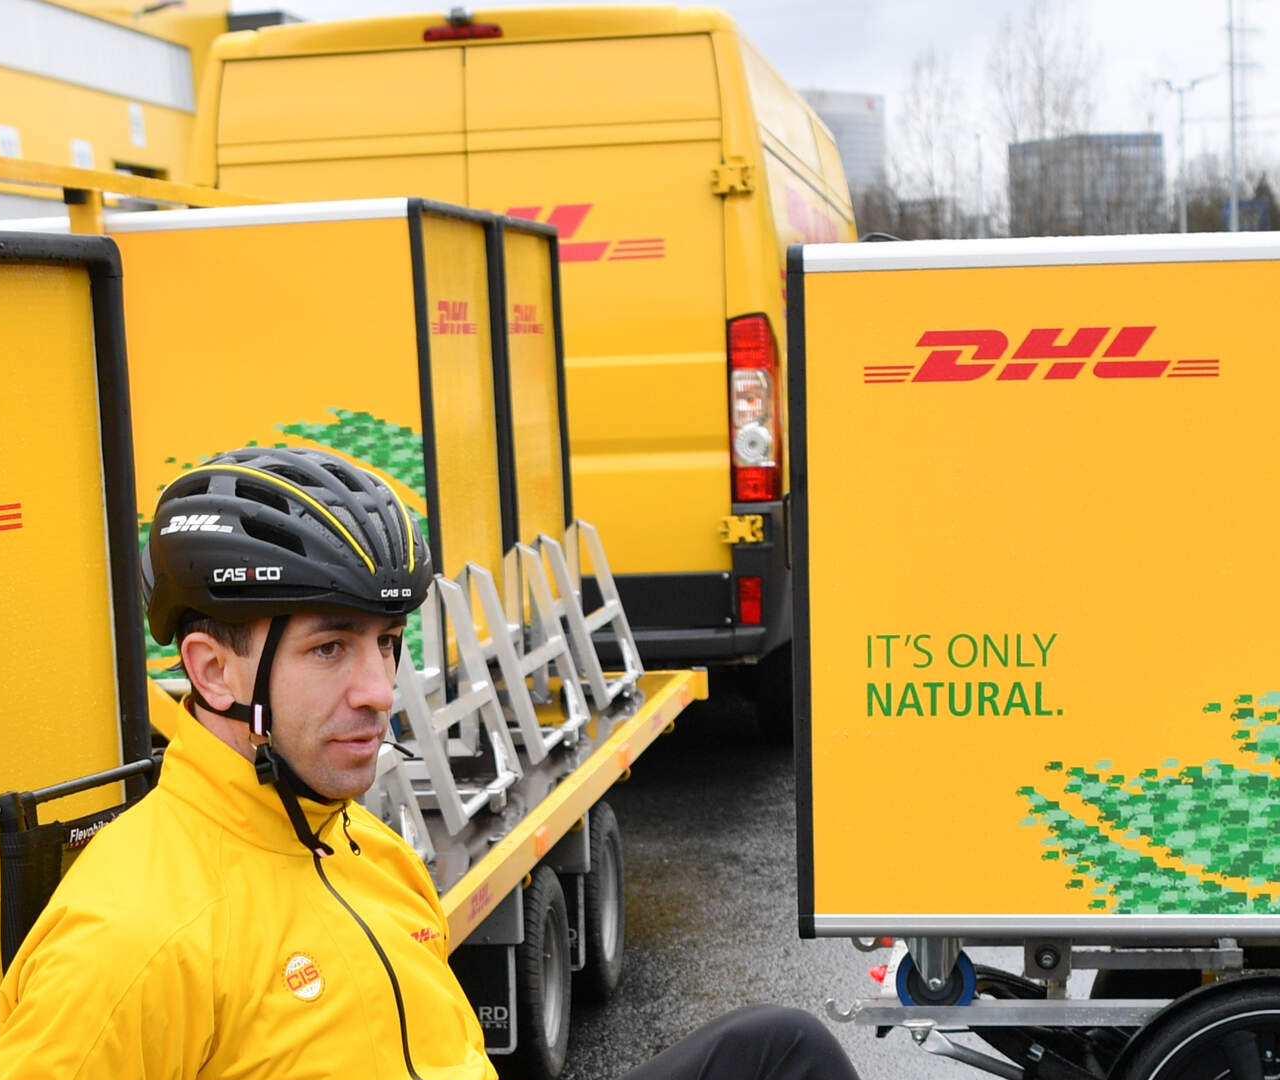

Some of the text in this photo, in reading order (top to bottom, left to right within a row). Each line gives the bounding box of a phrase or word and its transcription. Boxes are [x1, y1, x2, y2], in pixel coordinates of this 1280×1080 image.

[910, 326, 1172, 383] DHL
[167, 514, 224, 534] DHL
[867, 632, 1058, 668] IT'S ONLY
[867, 681, 1064, 717] NATURAL.
[286, 964, 320, 991] CIS
[479, 1005, 509, 1021] RD
